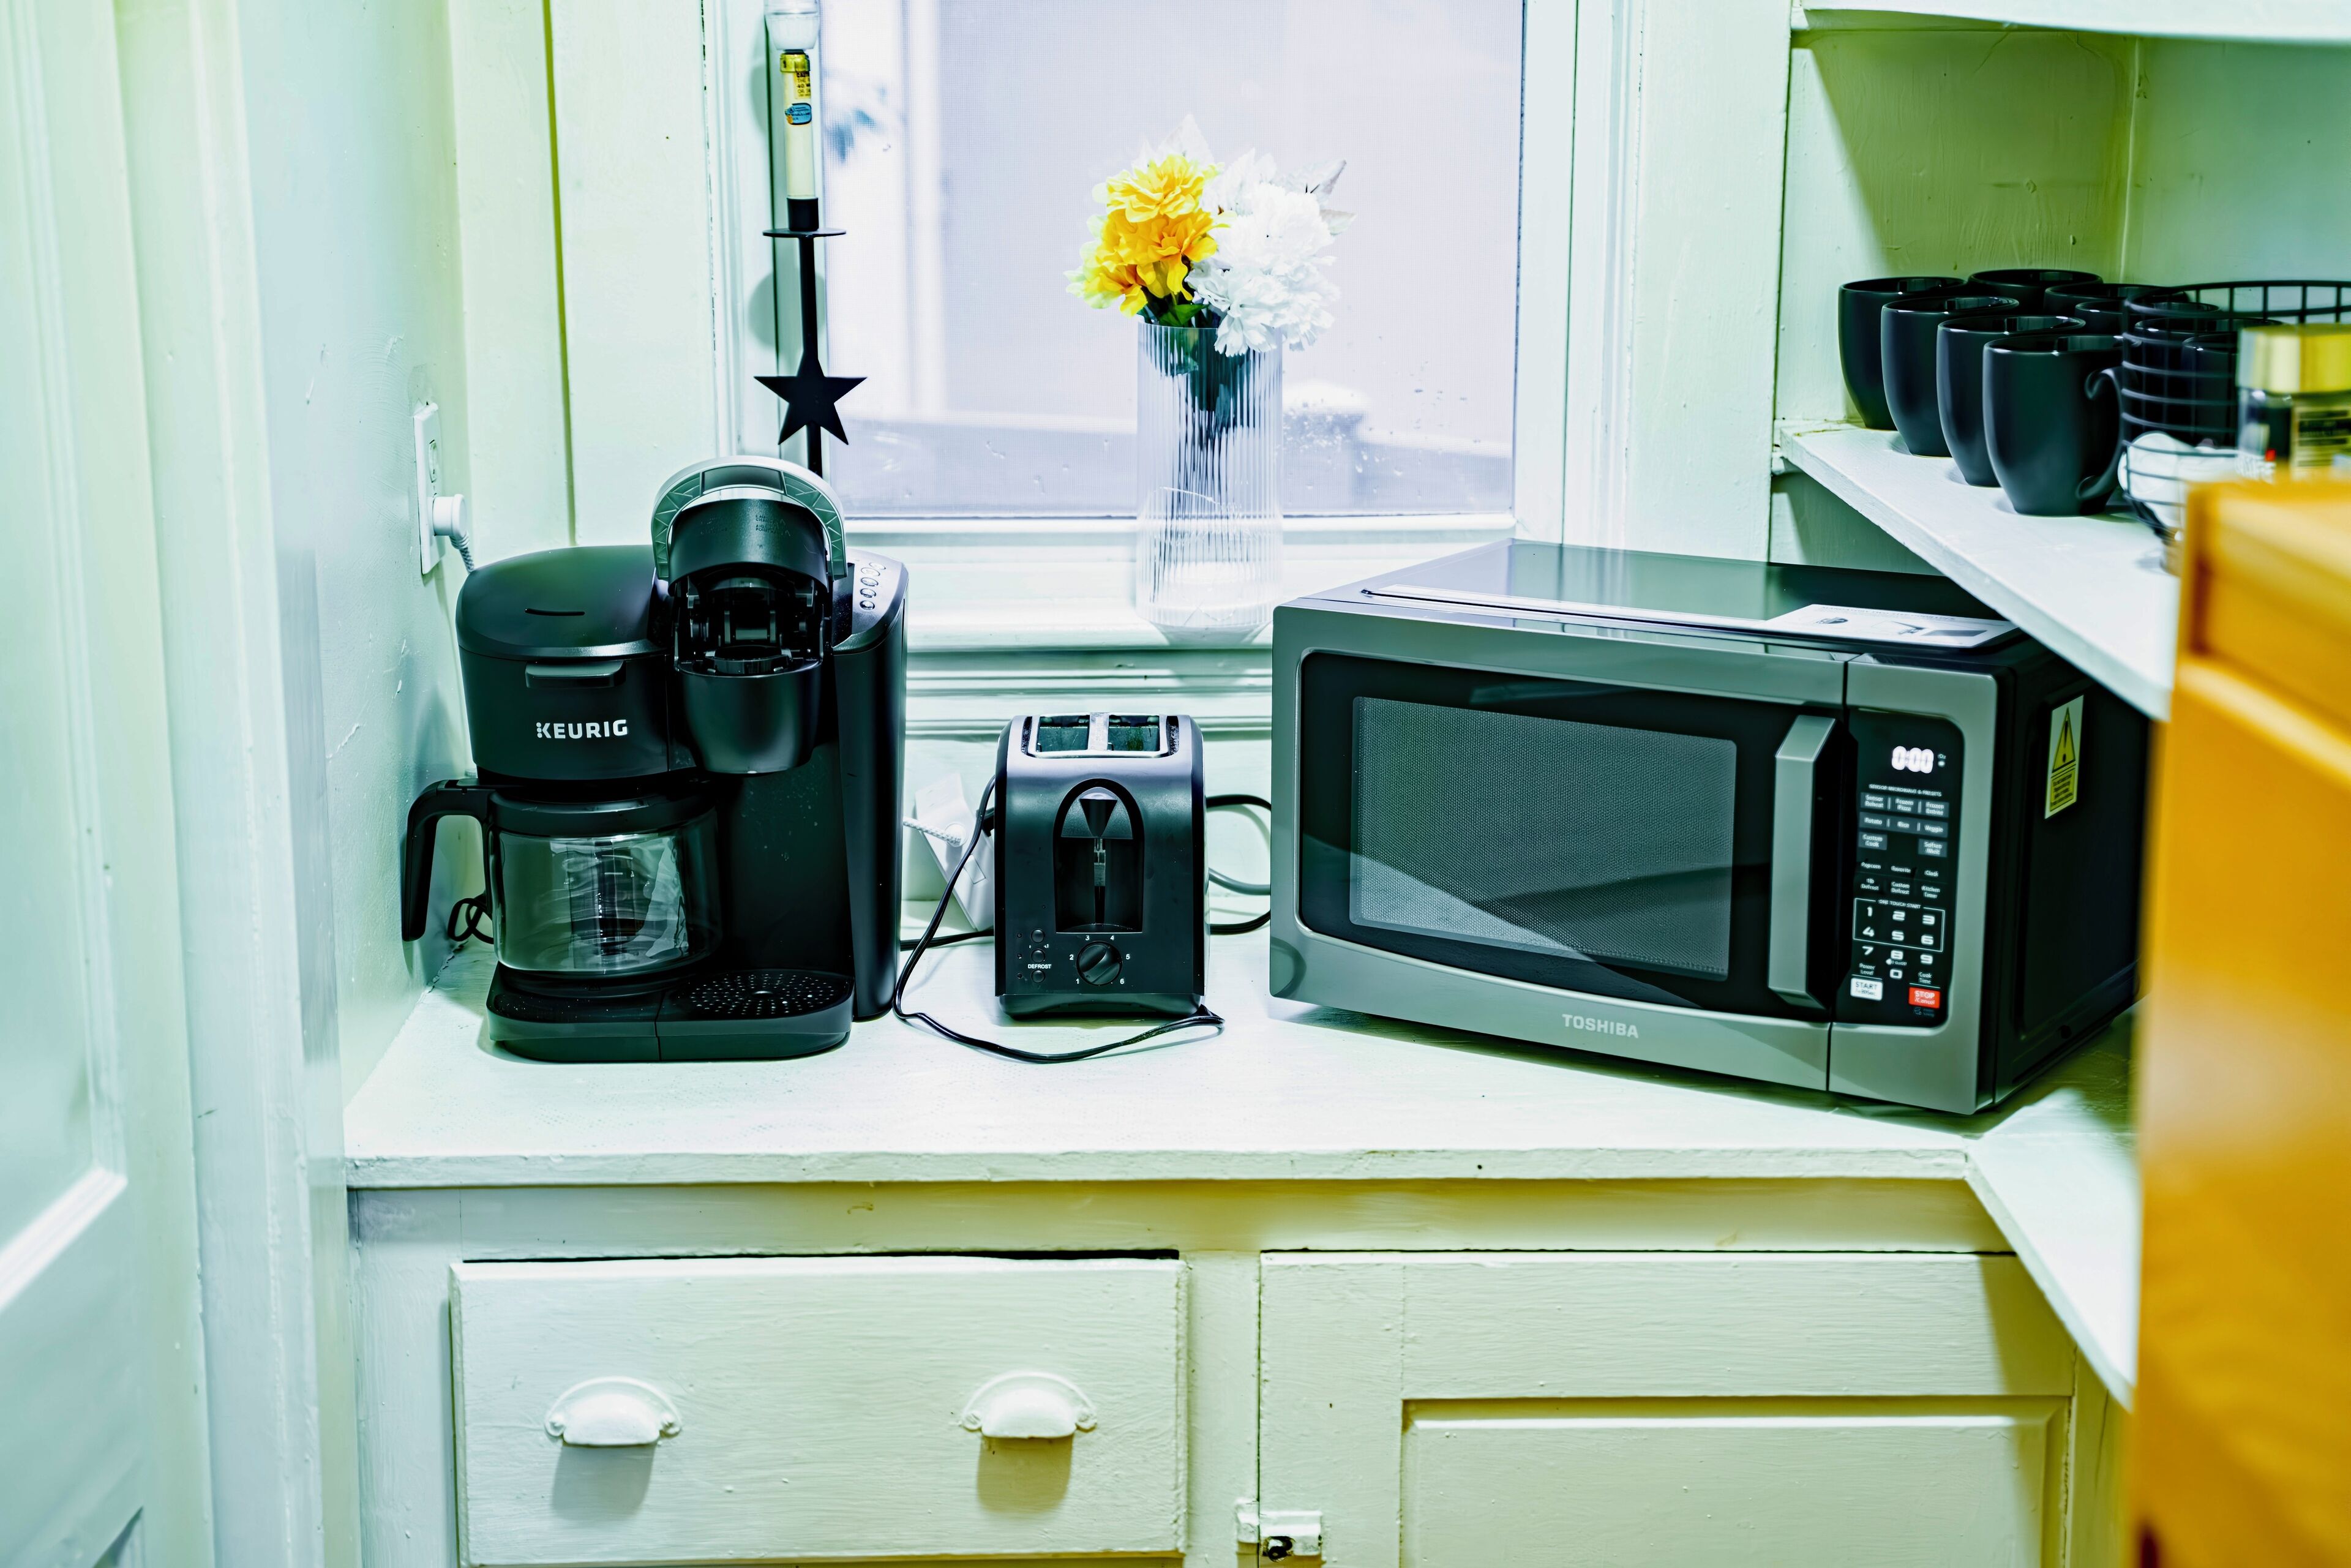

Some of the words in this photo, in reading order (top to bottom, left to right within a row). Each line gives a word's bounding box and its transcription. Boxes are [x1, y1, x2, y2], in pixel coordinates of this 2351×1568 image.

[536, 719, 628, 739] KEURIG
[1891, 746, 1934, 773] 0:00
[1867, 906, 1873, 917] 1
[1892, 910, 1905, 921] 2
[1922, 915, 1935, 925] 3
[1862, 926, 1875, 937] 4
[1891, 931, 1904, 942] 5
[1921, 935, 1934, 945] 6
[1862, 946, 1873, 956] 7
[1891, 950, 1903, 960] 8
[1920, 954, 1933, 965] 9
[1890, 969, 1903, 980] 0
[1856, 981, 1878, 990] START
[1914, 990, 1935, 999] STOP
[1562, 1013, 1639, 1039] TOSHIBA
